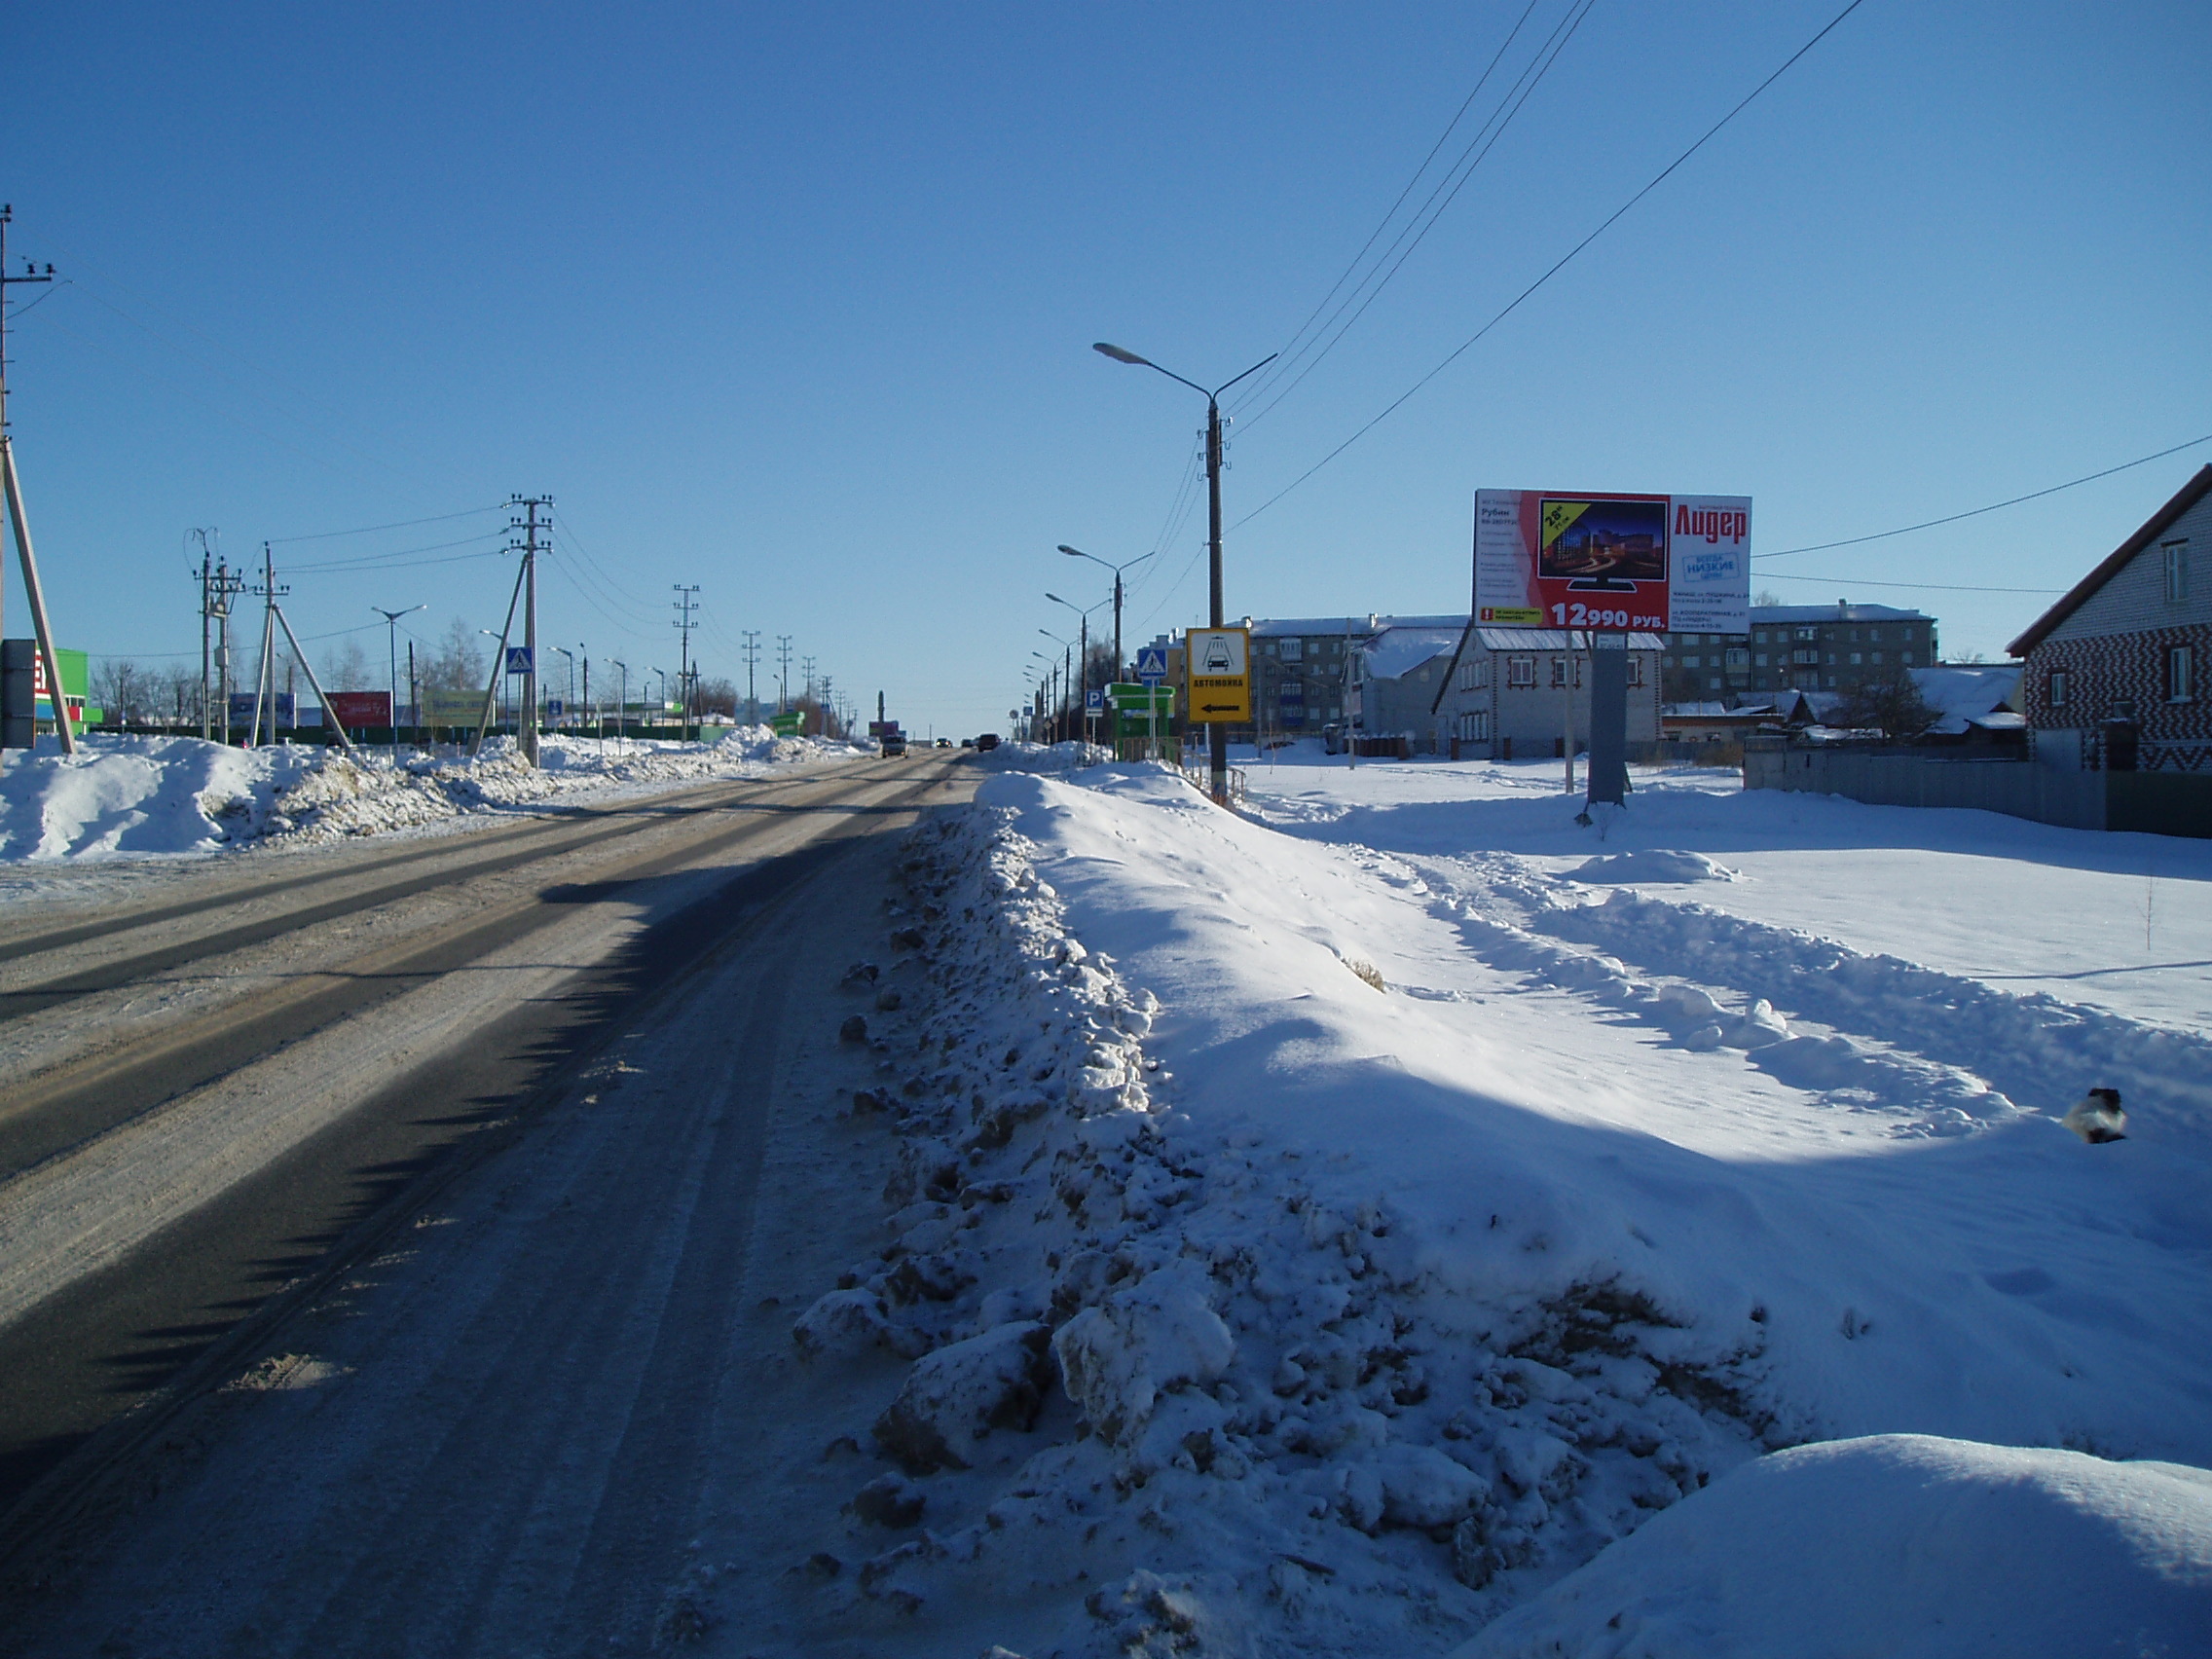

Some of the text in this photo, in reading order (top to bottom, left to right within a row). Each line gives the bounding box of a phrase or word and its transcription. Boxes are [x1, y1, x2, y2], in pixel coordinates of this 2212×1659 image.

[1481, 507, 1510, 517] Рубин
[1675, 504, 1747, 544] Лидер
[1687, 561, 1734, 573] НИЗКИЕ
[1632, 615, 1666, 629] РУБ.
[1194, 679, 1243, 687] АВТОМОЙКА
